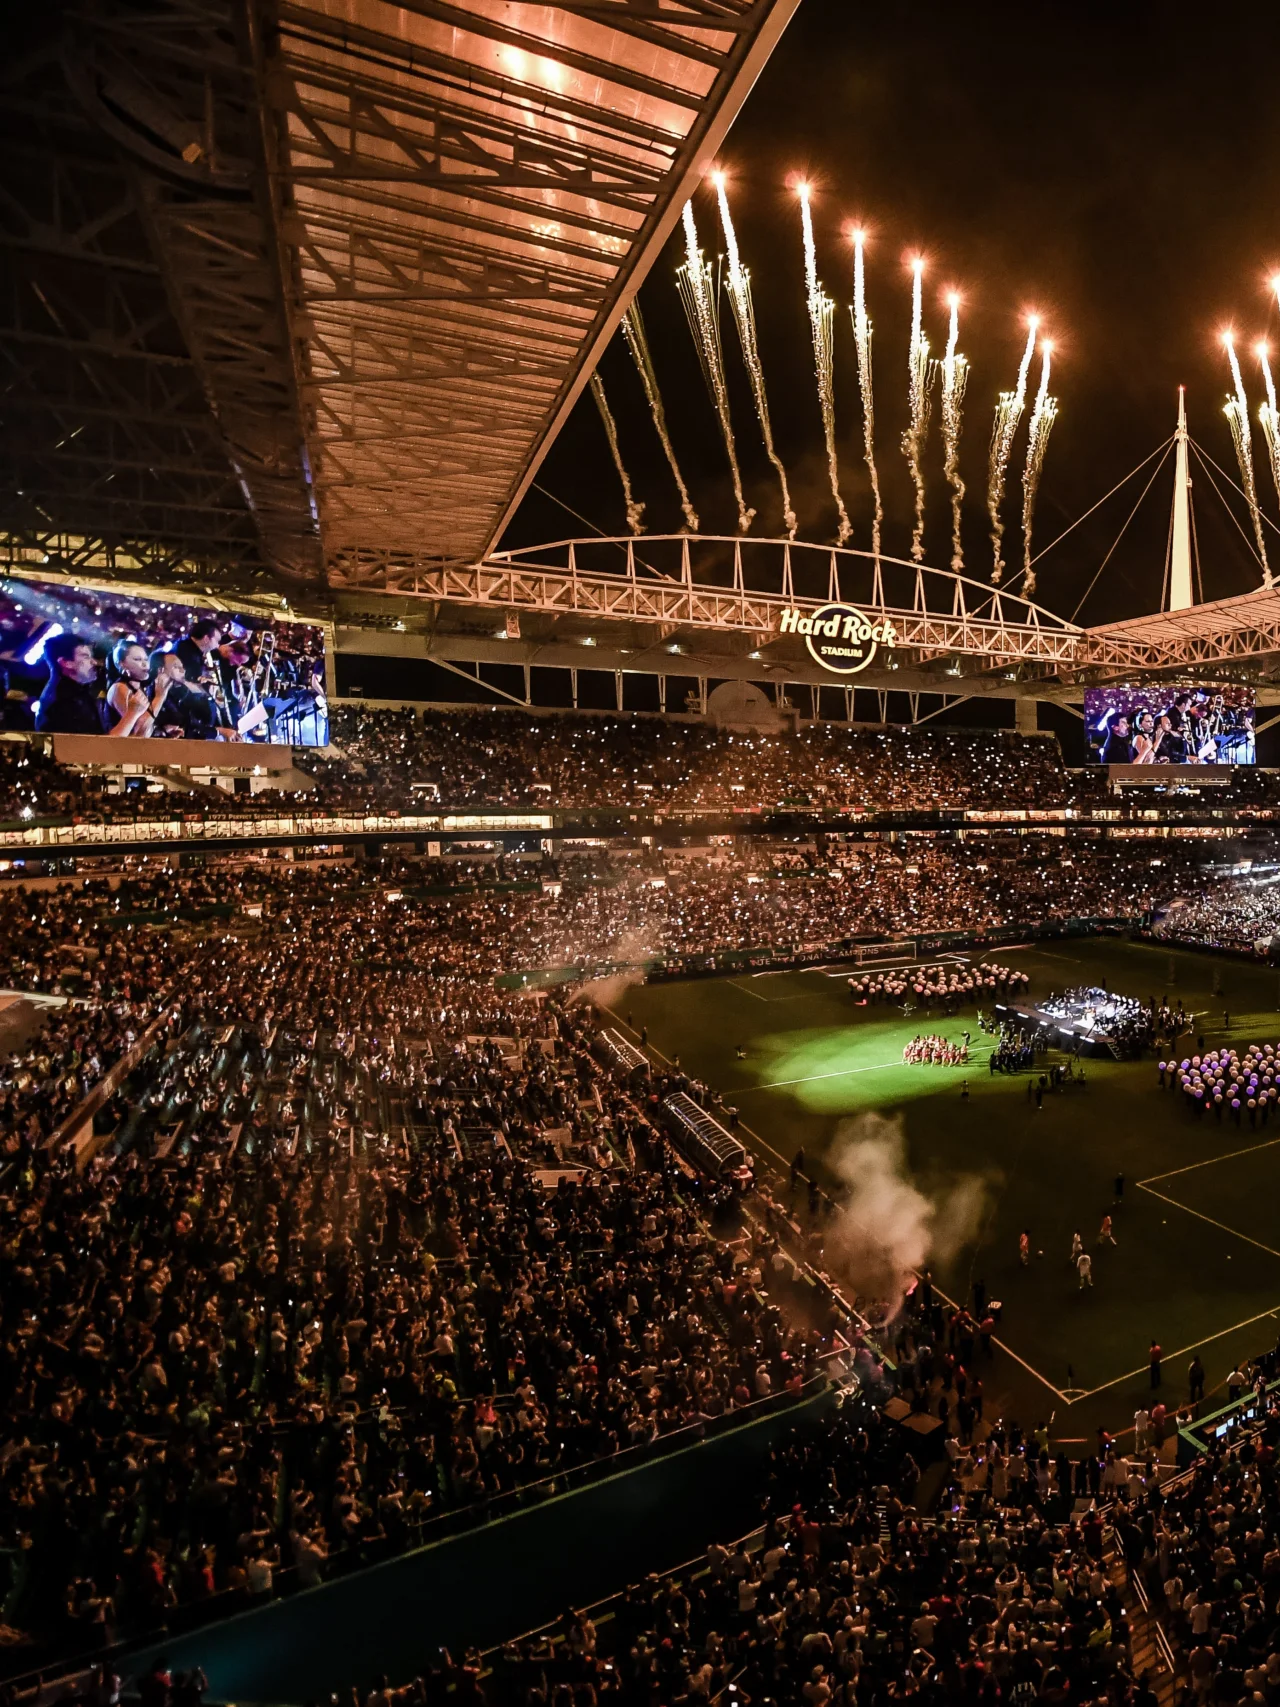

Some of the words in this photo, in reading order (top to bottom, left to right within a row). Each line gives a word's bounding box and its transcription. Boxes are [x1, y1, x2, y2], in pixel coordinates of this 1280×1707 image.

[780, 608, 842, 638] Hard
[842, 615, 897, 648] Rock
[820, 646, 863, 658] STADIUM
